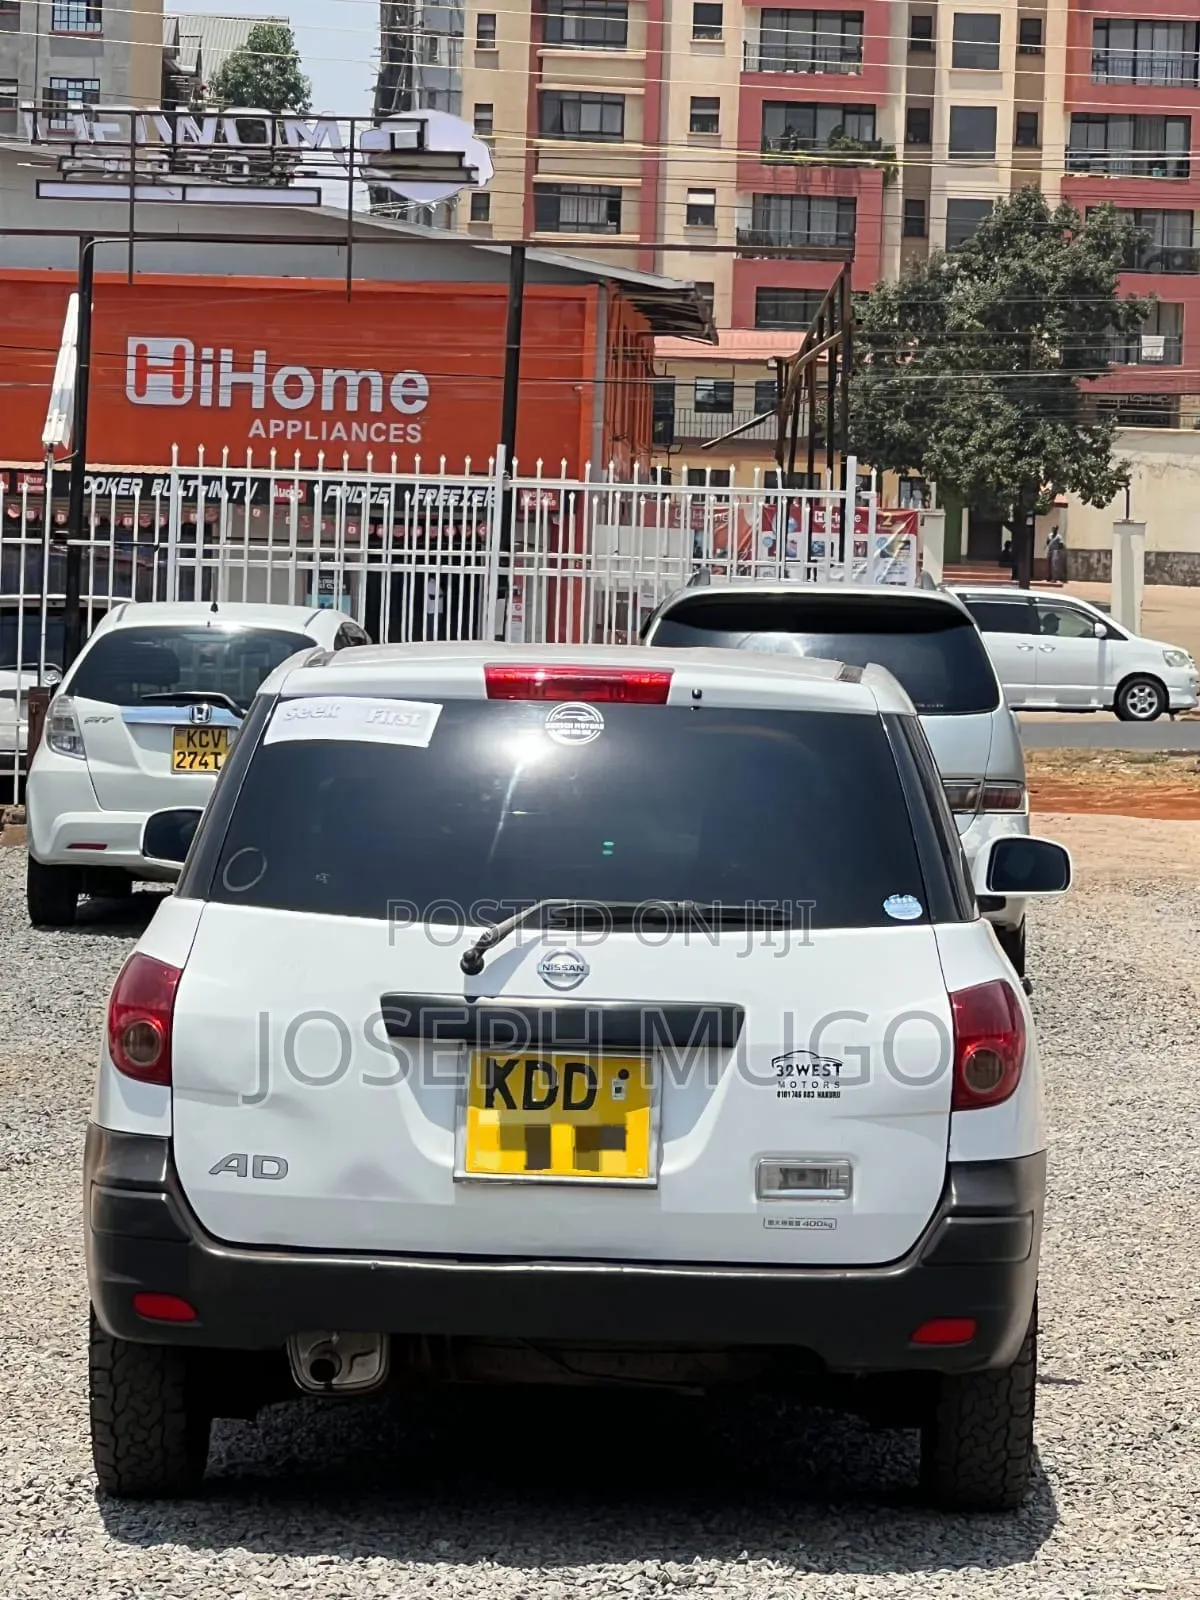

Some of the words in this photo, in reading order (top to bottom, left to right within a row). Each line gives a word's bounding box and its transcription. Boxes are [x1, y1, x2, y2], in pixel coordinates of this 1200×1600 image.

[248, 418, 423, 444] APPLIANCES
[69, 475, 143, 497] OOKER
[186, 730, 222, 748] KCV
[542, 963, 585, 973] NISSAN
[776, 1063, 843, 1077] 32WEST
[485, 1058, 598, 1111] KDD
[777, 1080, 840, 1089] MOTORS
[208, 1153, 289, 1180] AD
